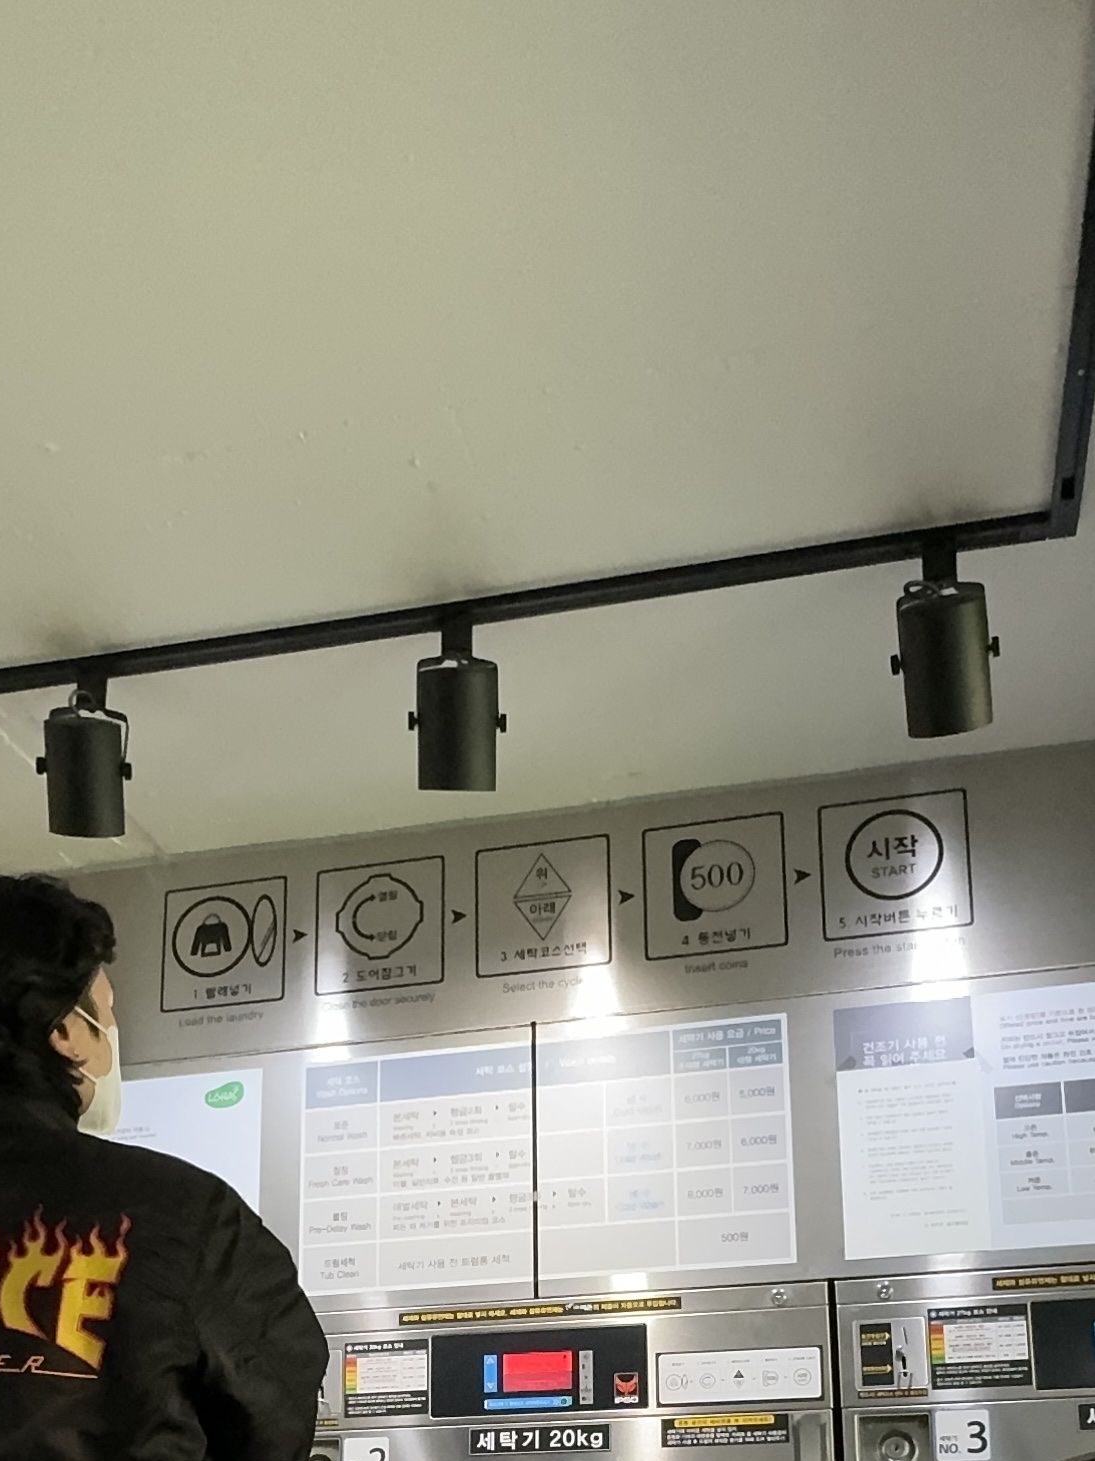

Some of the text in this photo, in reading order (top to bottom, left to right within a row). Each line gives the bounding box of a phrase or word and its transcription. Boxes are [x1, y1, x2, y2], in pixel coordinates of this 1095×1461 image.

[866, 834, 919, 861] 시작
[536, 867, 548, 880] 위
[690, 862, 744, 892] 500
[870, 863, 917, 879] START
[529, 902, 556, 914] 아래
[833, 943, 892, 960] Press the
[356, 965, 417, 982] 도어잠그기
[684, 958, 748, 974] Insert coins
[205, 983, 253, 1000] 빨래넣기
[502, 979, 554, 994] Select the
[206, 1014, 223, 1024] the
[727, 1029, 744, 1040] 요금
[754, 1027, 776, 1036] Price
[863, 1039, 899, 1054] 건조기
[721, 1232, 748, 1243] 500원
[337, 1271, 359, 1279] Clean
[477, 1429, 603, 1450] 세탁기 20kg
[939, 1421, 988, 1454] NO. 3
